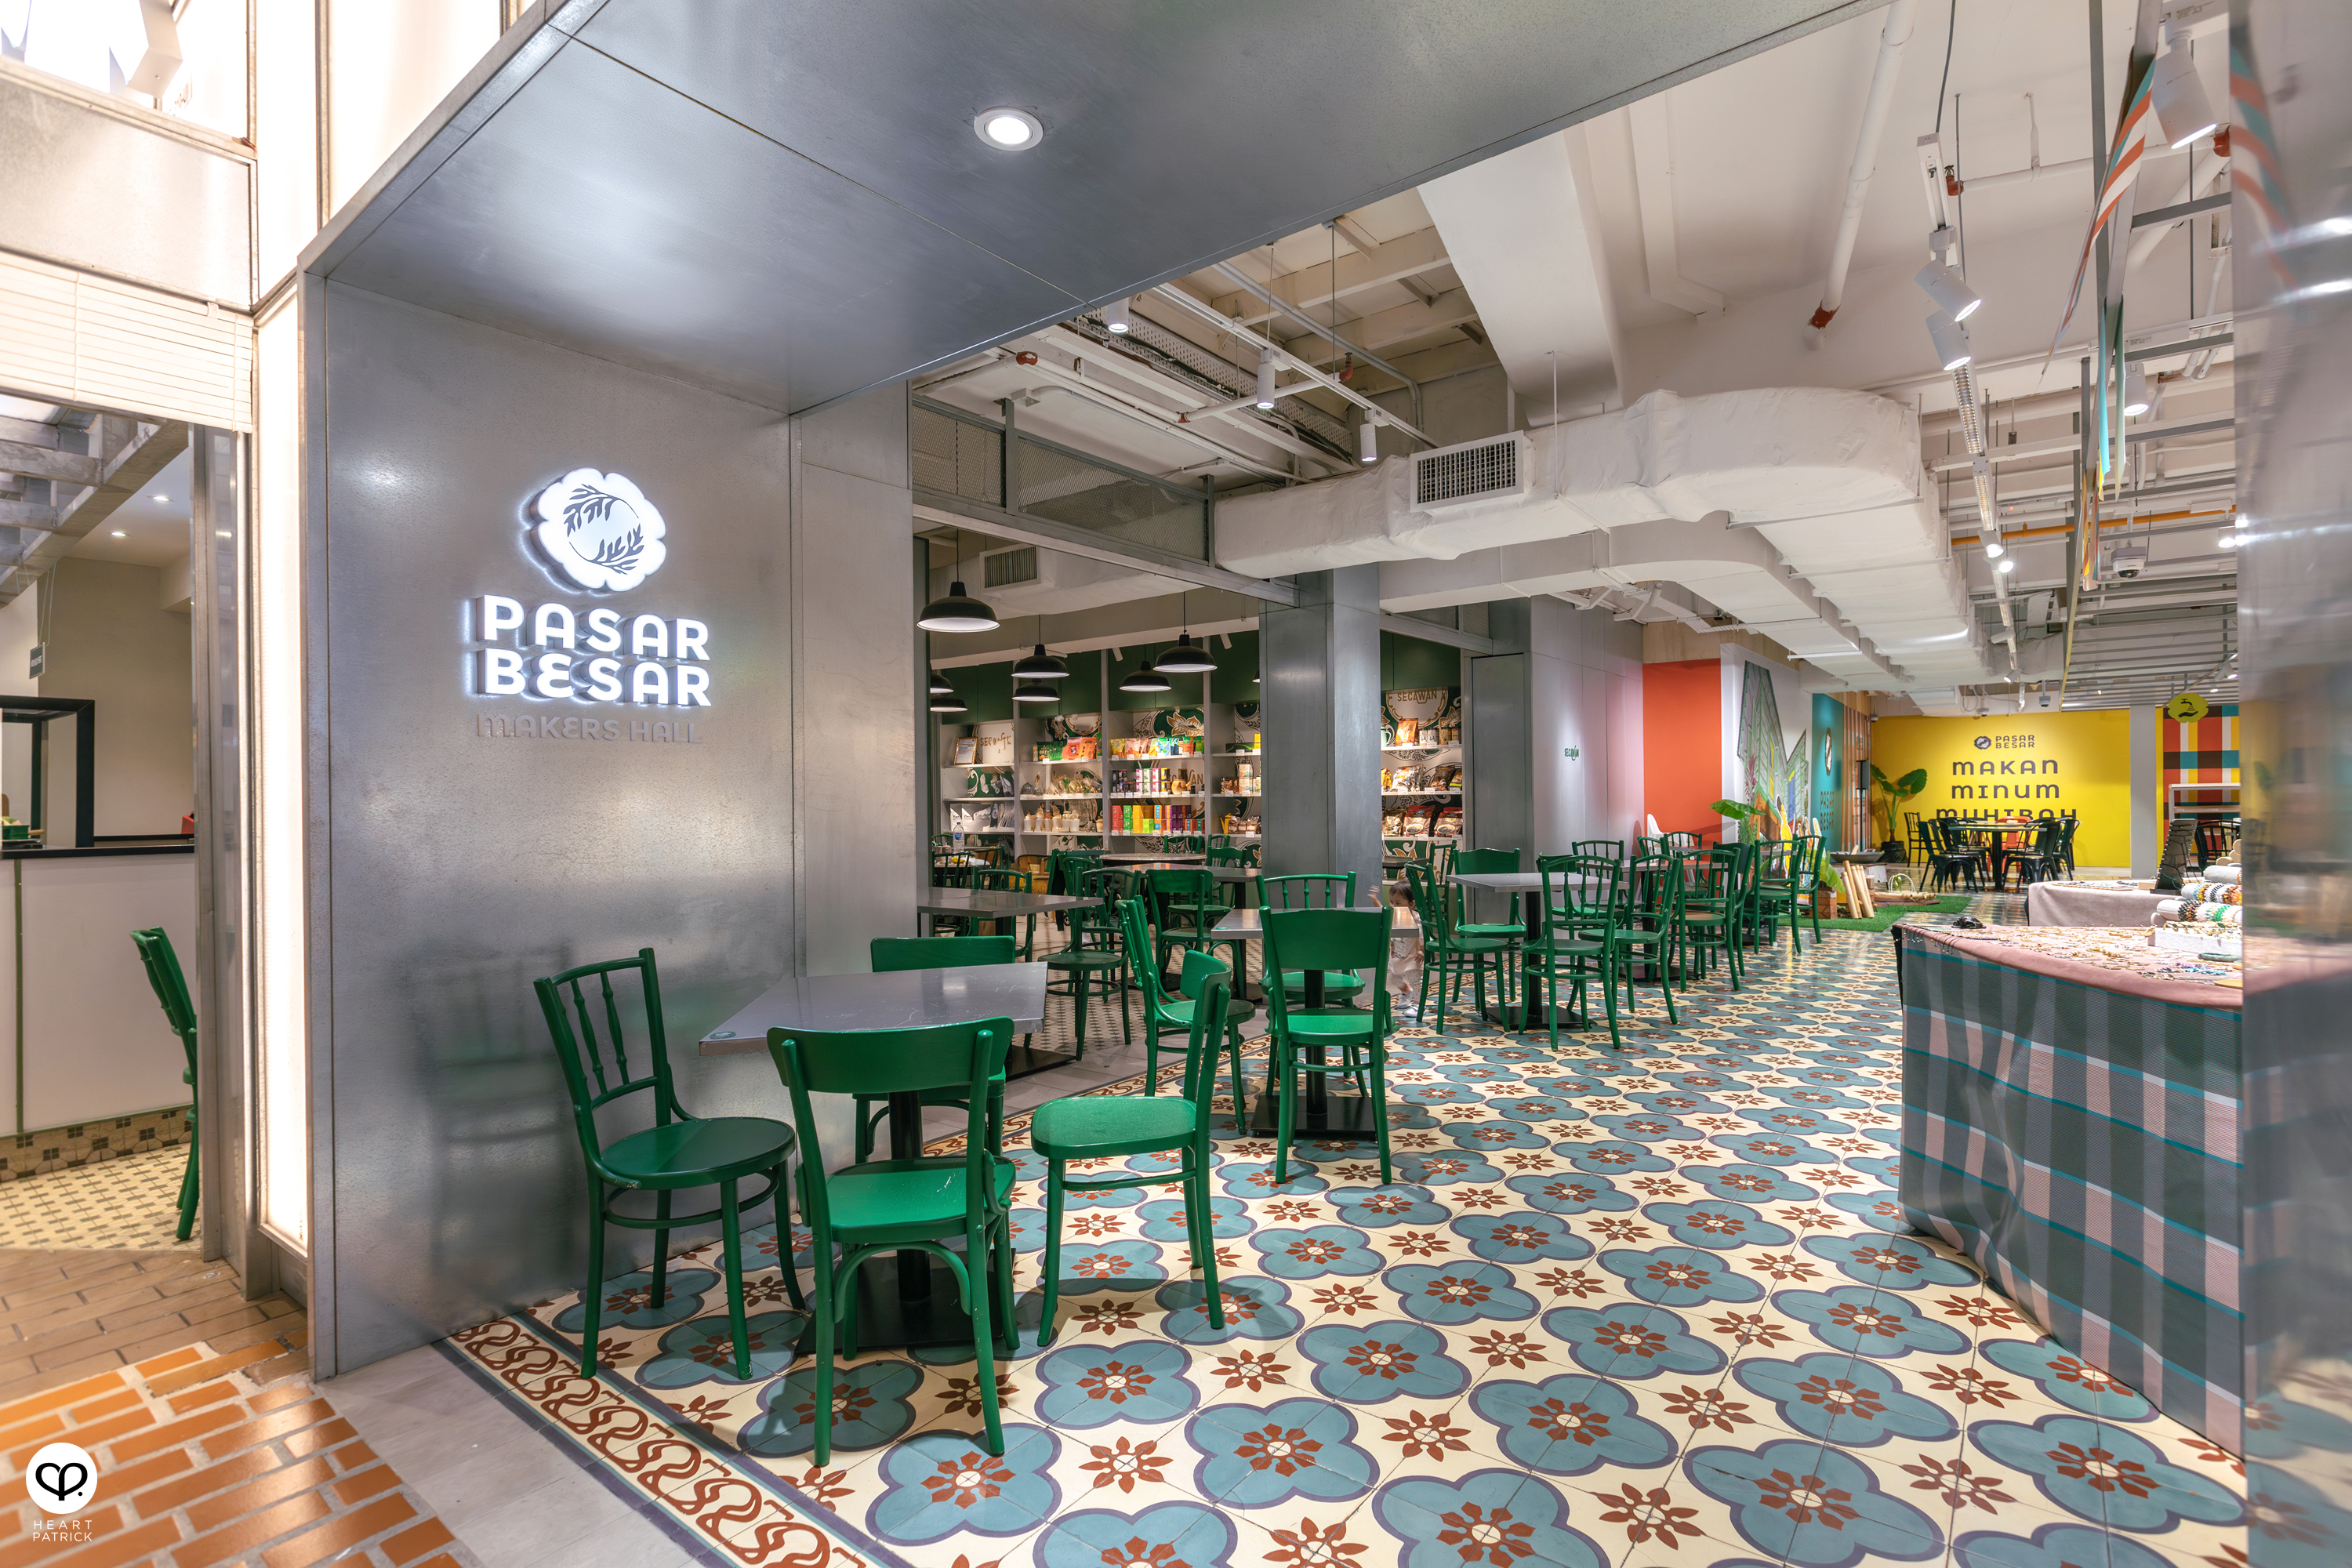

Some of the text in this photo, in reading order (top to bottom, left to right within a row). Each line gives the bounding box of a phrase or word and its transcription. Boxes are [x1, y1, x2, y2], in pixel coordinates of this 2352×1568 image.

[480, 594, 710, 660] PASAR
[481, 648, 711, 706] BESAR
[1397, 691, 1437, 704] SECAWAN
[477, 713, 702, 743] MAKERS HALL
[1952, 760, 2059, 775] MAKAN
[1820, 791, 1834, 810] PASAR
[1951, 784, 2060, 799] MINUM
[1820, 811, 1834, 831] BESAR
